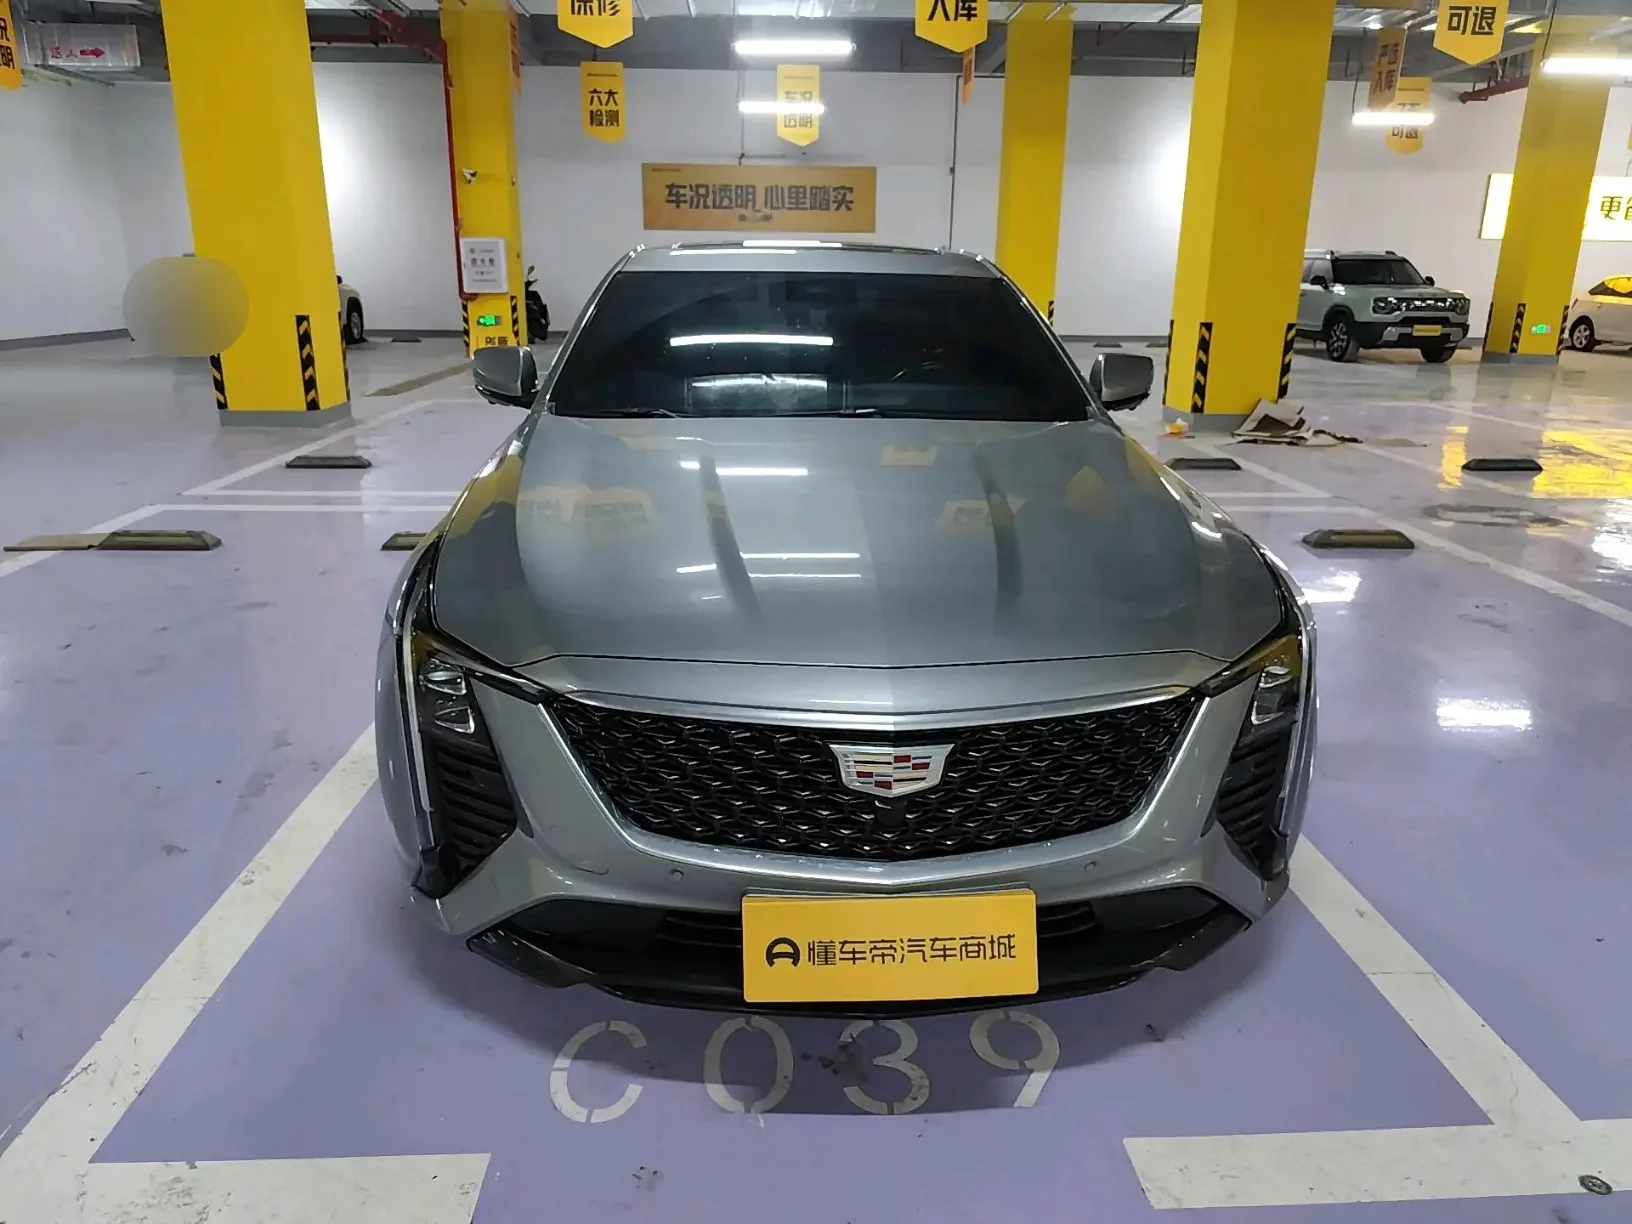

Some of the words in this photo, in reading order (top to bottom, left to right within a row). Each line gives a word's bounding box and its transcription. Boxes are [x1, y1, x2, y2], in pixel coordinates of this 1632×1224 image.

[1447, 6, 1497, 35] 可退
[588, 88, 619, 106] 六大
[589, 109, 620, 127] 检测
[665, 183, 760, 212] 车况透明
[764, 185, 854, 212] 心里踏实
[807, 933, 1017, 966] 懂车帝汽车商城
